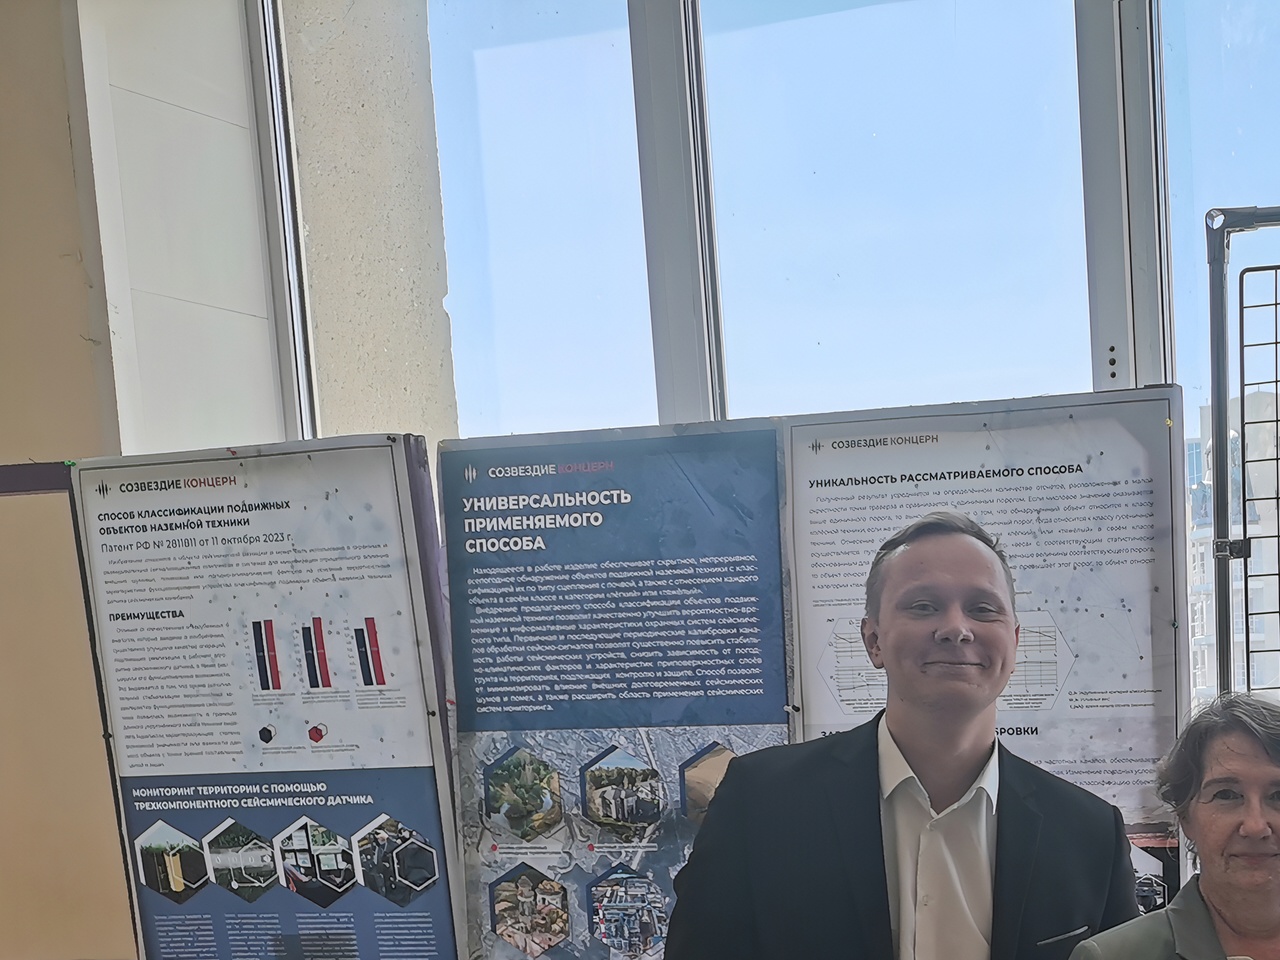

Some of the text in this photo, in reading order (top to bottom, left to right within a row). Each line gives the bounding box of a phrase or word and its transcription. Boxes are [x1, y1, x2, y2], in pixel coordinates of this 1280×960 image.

[831, 434, 939, 450] СОЗВЕЗДИЕ КОНЦЕРН
[488, 461, 614, 478] СОЗВЕЗДИЕ КОНЦЕРН
[809, 464, 1083, 489] УНИКАЛЬНОСТЬ РАССМАТРИВАЕМОГО СПОСОБА
[119, 476, 237, 493] СОЗВЕЗДИЕ КОНЦЕРН
[462, 490, 631, 512] УНИВЕРСАЛЬНОСТЬ
[98, 500, 291, 522] СПОСОБ КЛАССИФИКАЦИИ ПОДВИЖНЫХ
[99, 518, 250, 536] ОБЪЕКТОВ НАЗЕМНОЙ ТЕХНИКИ
[464, 512, 603, 532] ПРИМЕНЯЕМОГО
[101, 543, 134, 553] Патент
[136, 541, 151, 550] РФ
[198, 538, 209, 547] от
[220, 534, 261, 546] октября
[262, 532, 285, 543] 2023
[466, 536, 546, 553] СПОСОБА
[109, 610, 185, 622] ПРЕИМУЩЕСТВА
[132, 783, 327, 797] МОНИТОРИНГ ТЕРРИТОРИИ С ПОМОЩЬЮ
[134, 795, 374, 811] ТРЕХКОМПОНЕНТНОГО СЕЙСМИЧЕСКОГО ДАТЧИКА
